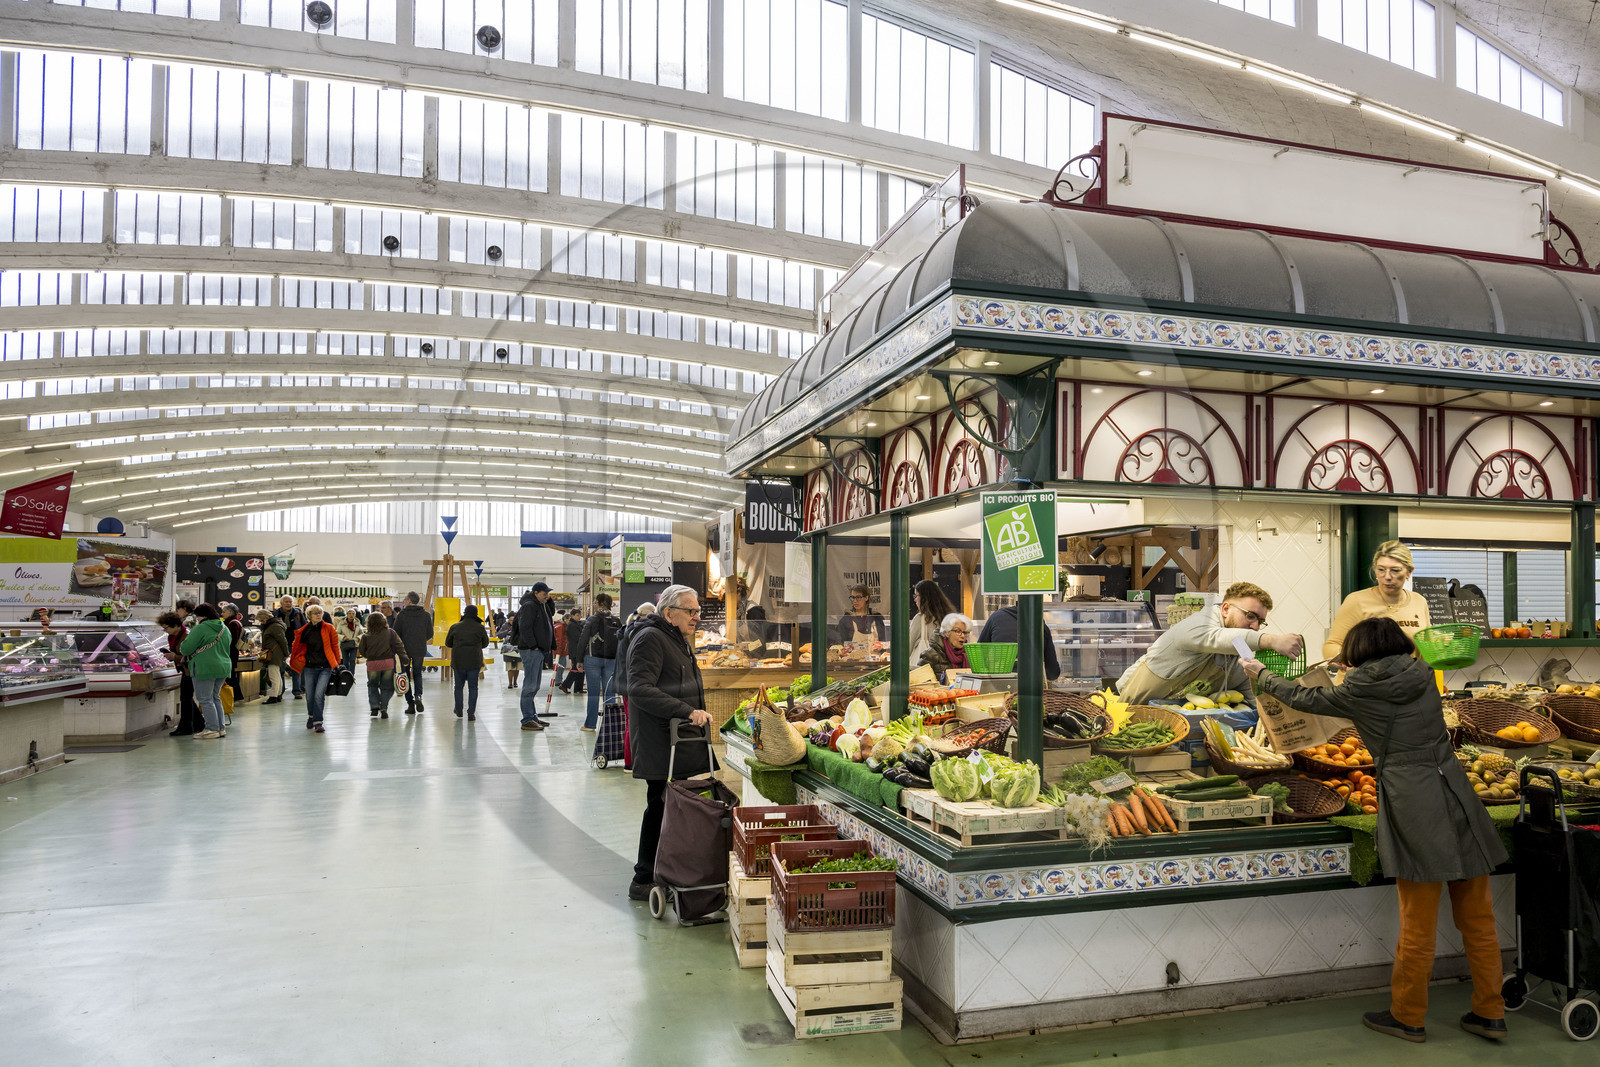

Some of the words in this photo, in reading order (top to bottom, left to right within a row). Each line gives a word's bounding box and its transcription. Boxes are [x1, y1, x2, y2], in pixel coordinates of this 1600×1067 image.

[984, 496, 995, 504] ICI
[997, 494, 1037, 504] PRODUITS
[1040, 493, 1054, 502] BIO
[997, 519, 1030, 553] AB
[626, 551, 643, 563] AB
[996, 543, 1041, 562] AGRICULTURE
[997, 550, 1043, 568] BIOLOGIQUE
